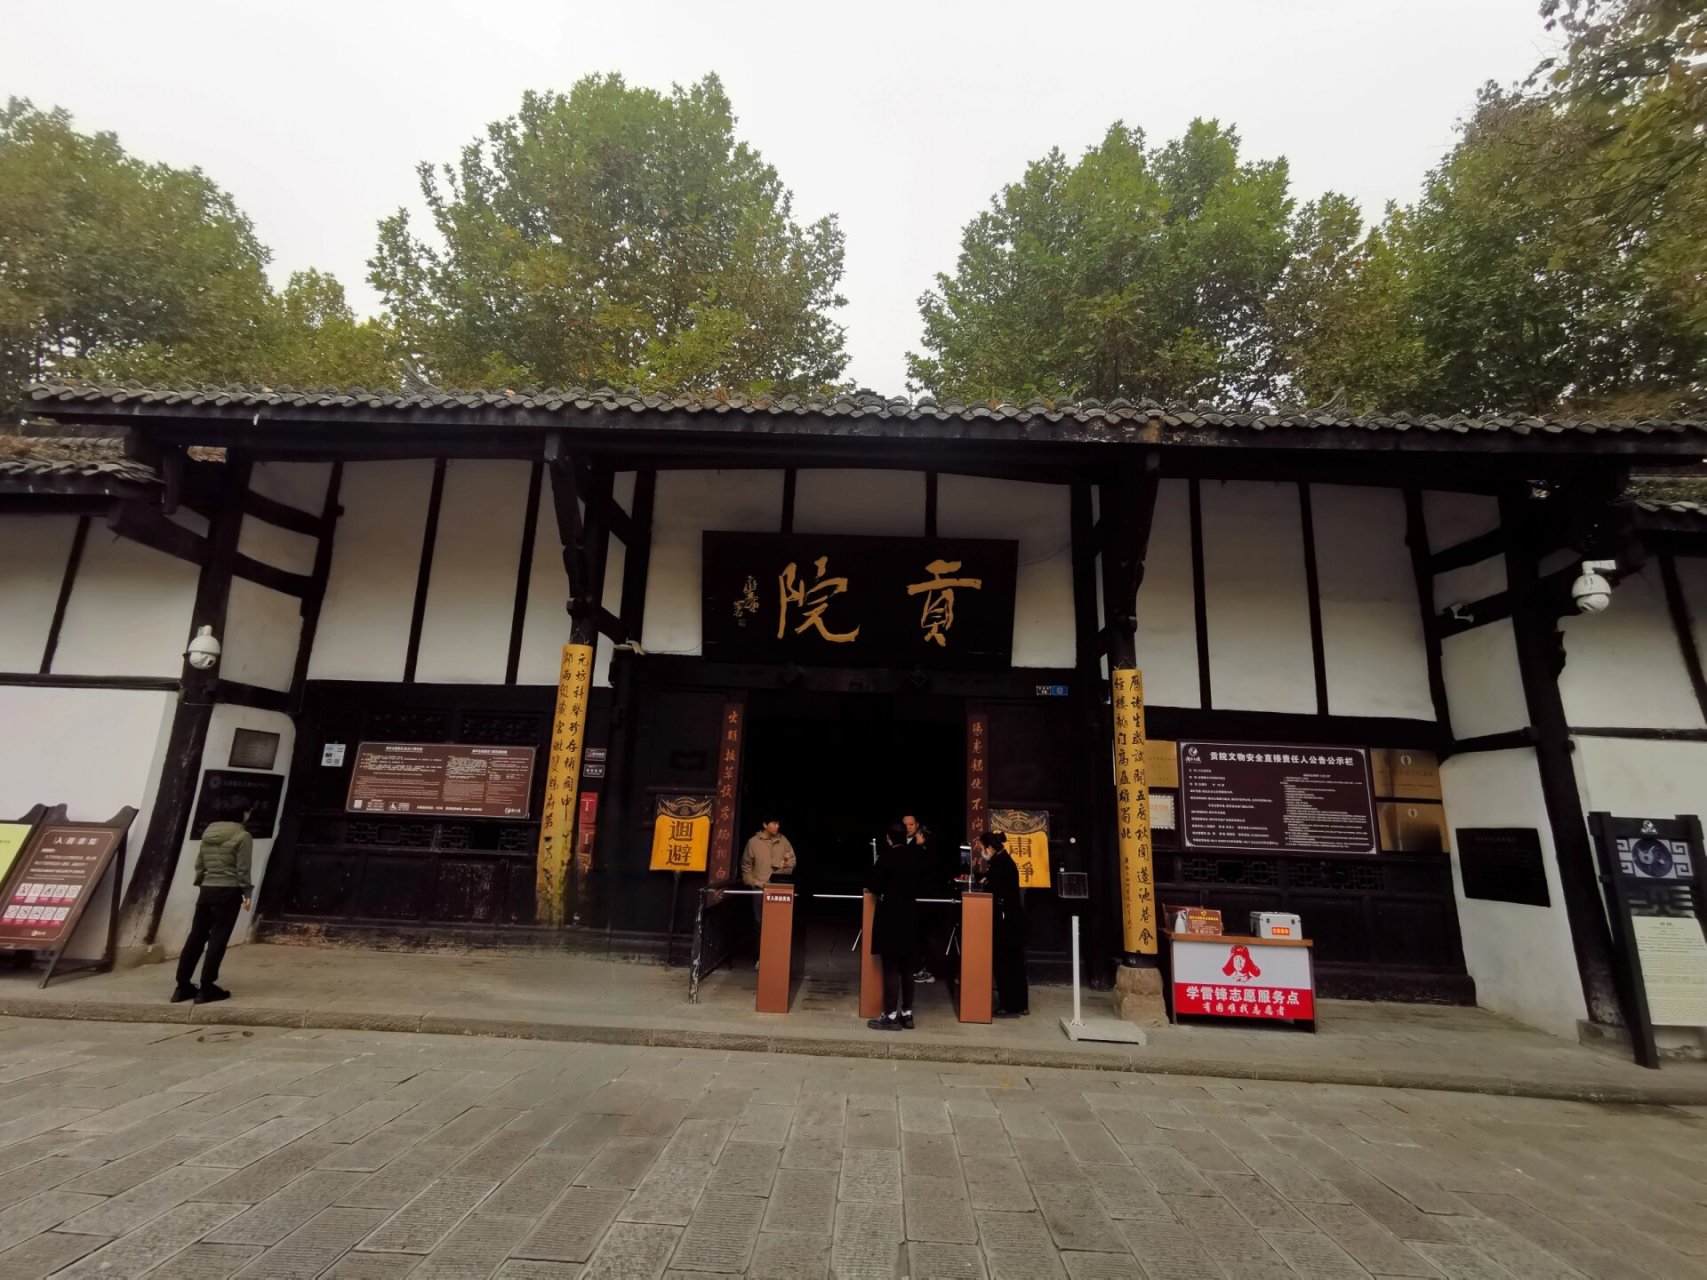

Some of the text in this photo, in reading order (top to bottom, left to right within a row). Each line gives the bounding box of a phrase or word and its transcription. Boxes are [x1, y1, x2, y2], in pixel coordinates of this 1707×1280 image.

[1186, 986, 1300, 1005] 学雷锋志愿服务点
